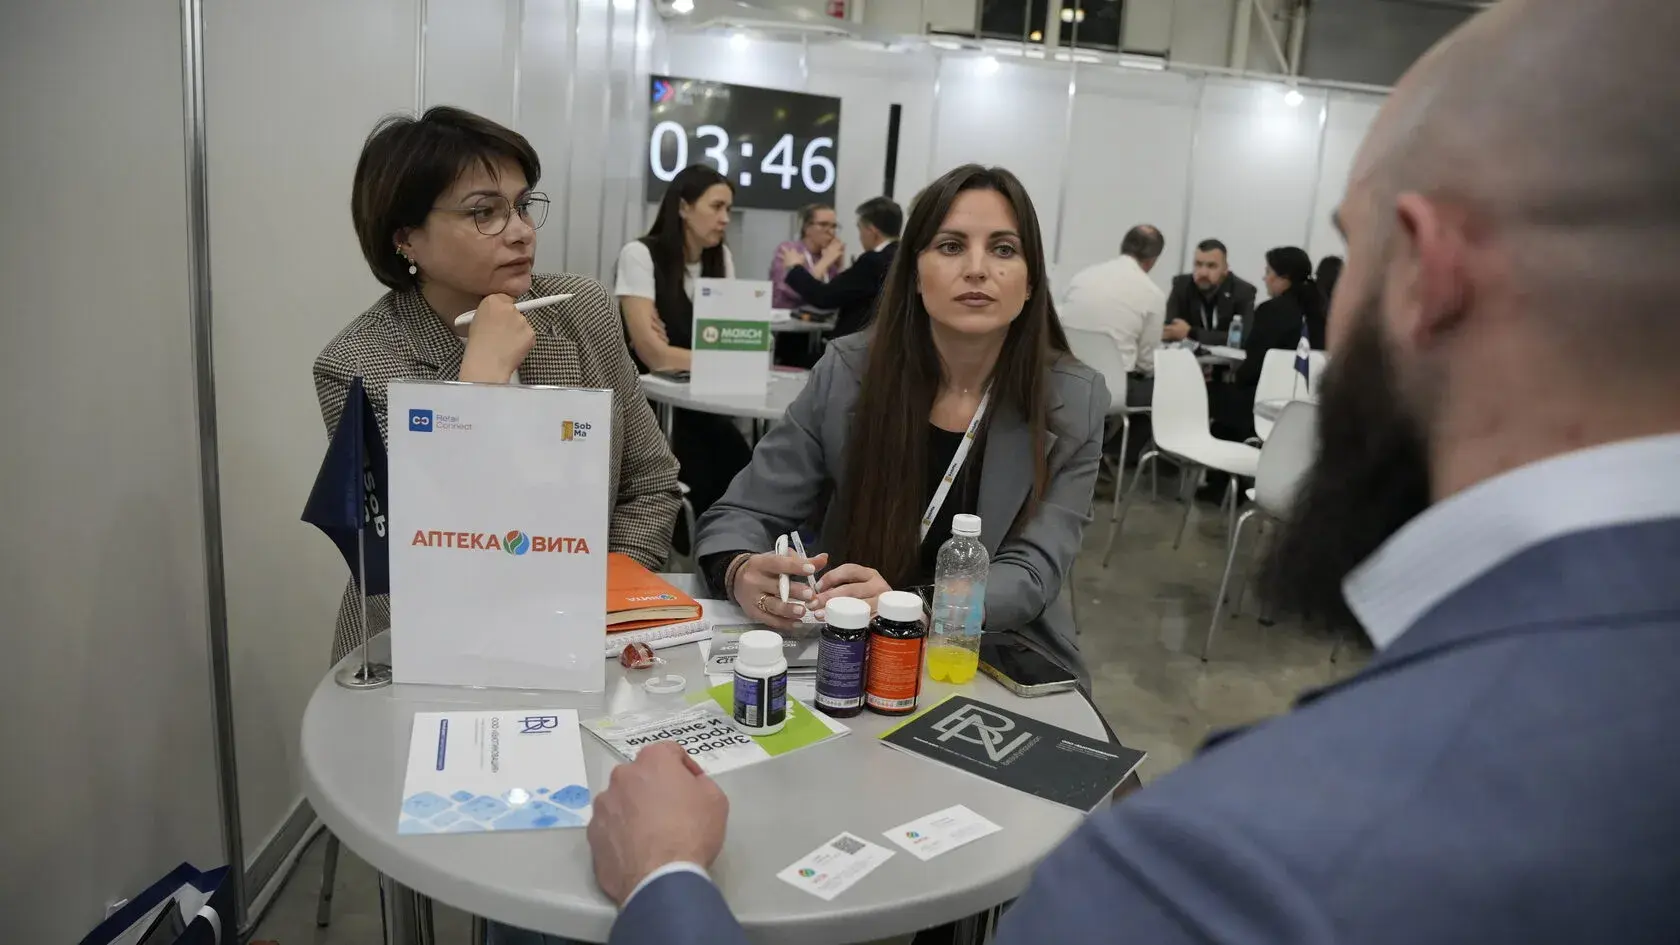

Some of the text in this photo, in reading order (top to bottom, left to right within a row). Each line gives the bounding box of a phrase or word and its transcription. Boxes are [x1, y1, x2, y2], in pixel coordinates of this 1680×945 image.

[650, 120, 836, 194] 03:46
[436, 414, 460, 423] Retail
[436, 422, 473, 431] Connect
[574, 422, 592, 430] Sob
[411, 530, 590, 554] АПТЕКА ВИТА
[626, 722, 706, 746] энергия
[686, 735, 751, 755] Здоро
